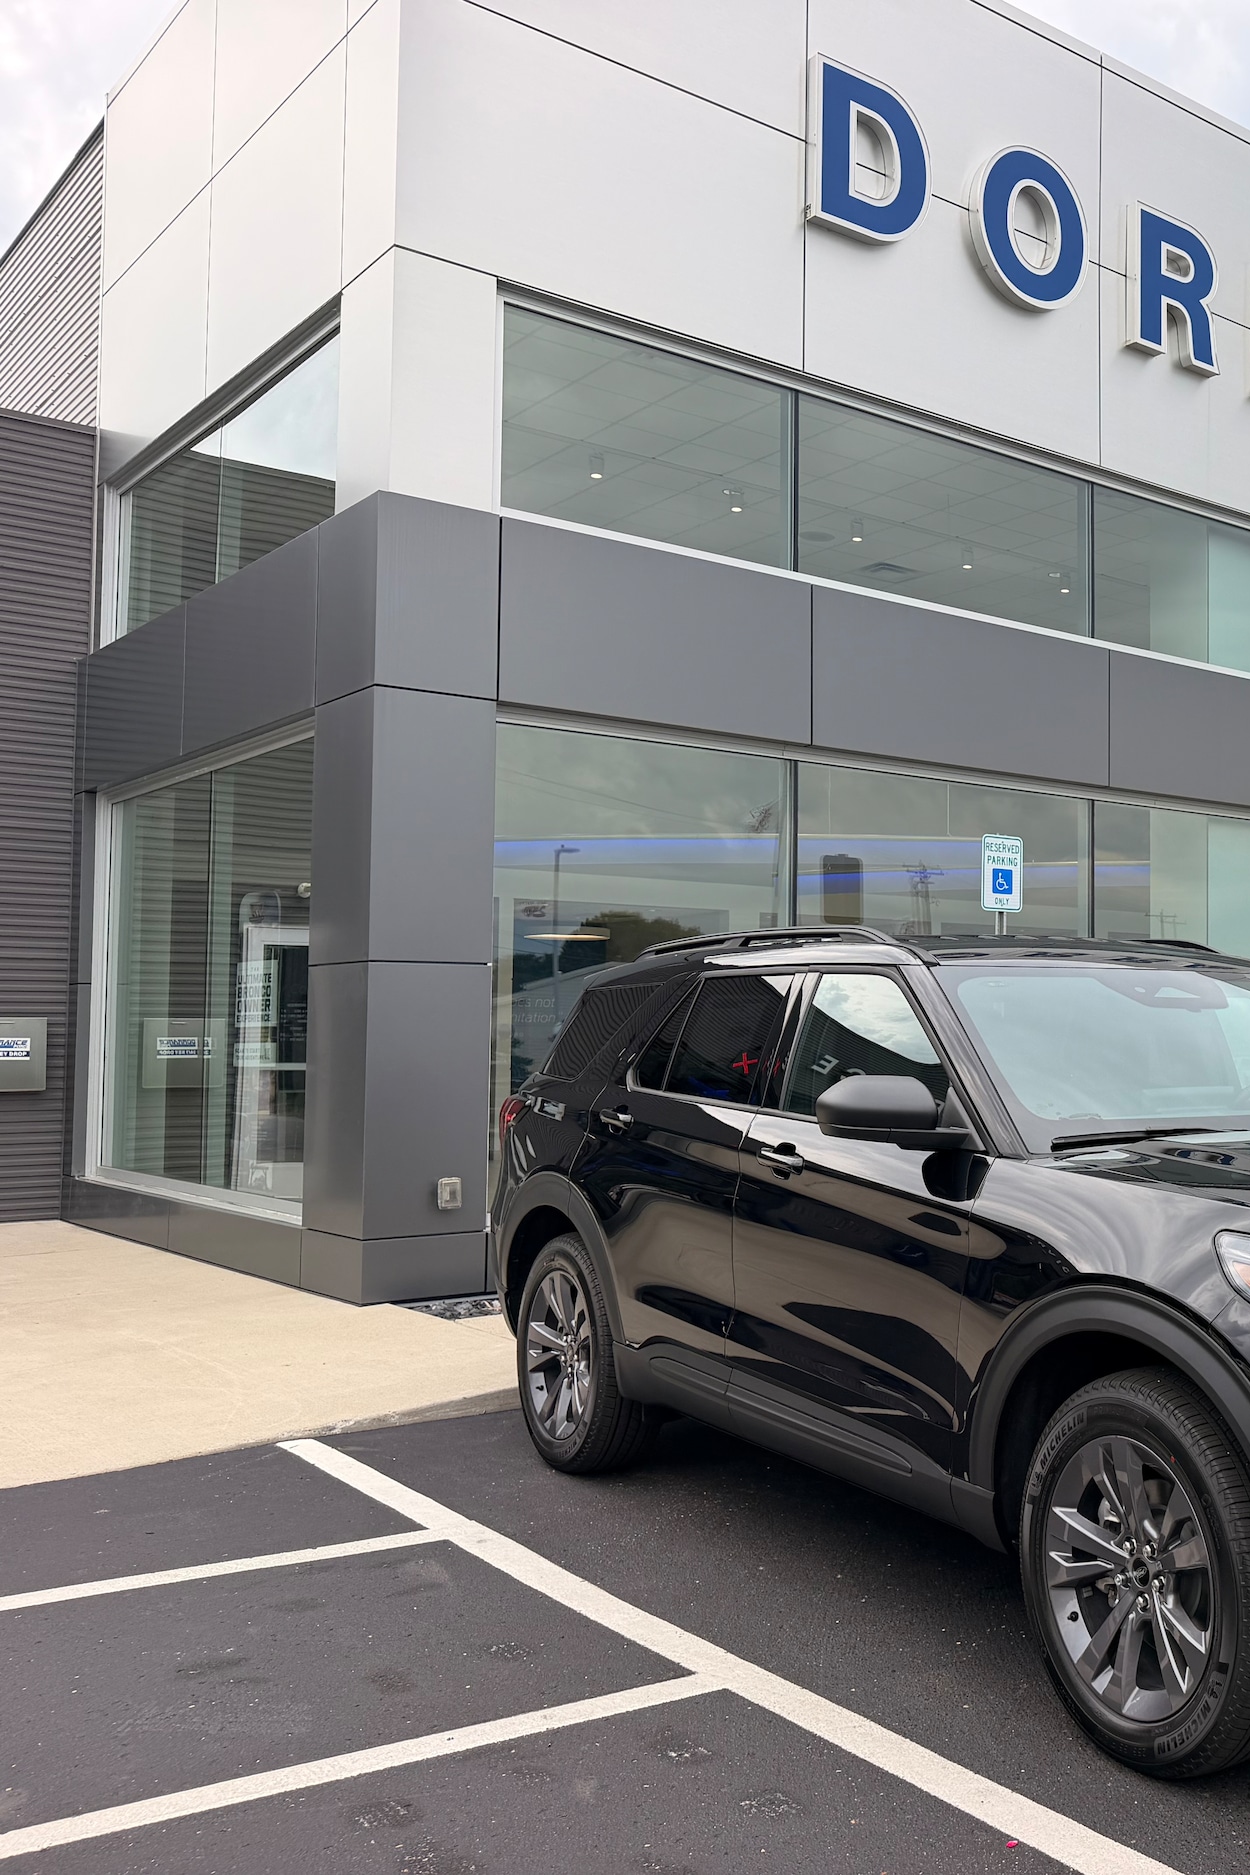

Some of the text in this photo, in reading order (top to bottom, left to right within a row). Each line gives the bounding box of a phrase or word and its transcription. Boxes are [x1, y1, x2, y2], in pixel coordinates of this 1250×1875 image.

[985, 841, 1020, 855] RESERVED
[986, 855, 1018, 867] PARKING
[994, 897, 1010, 906] ONLY
[237, 984, 272, 999] BRONCO
[1039, 1411, 1085, 1470] MICHELIN
[1156, 1699, 1212, 1756] MICHELIN
